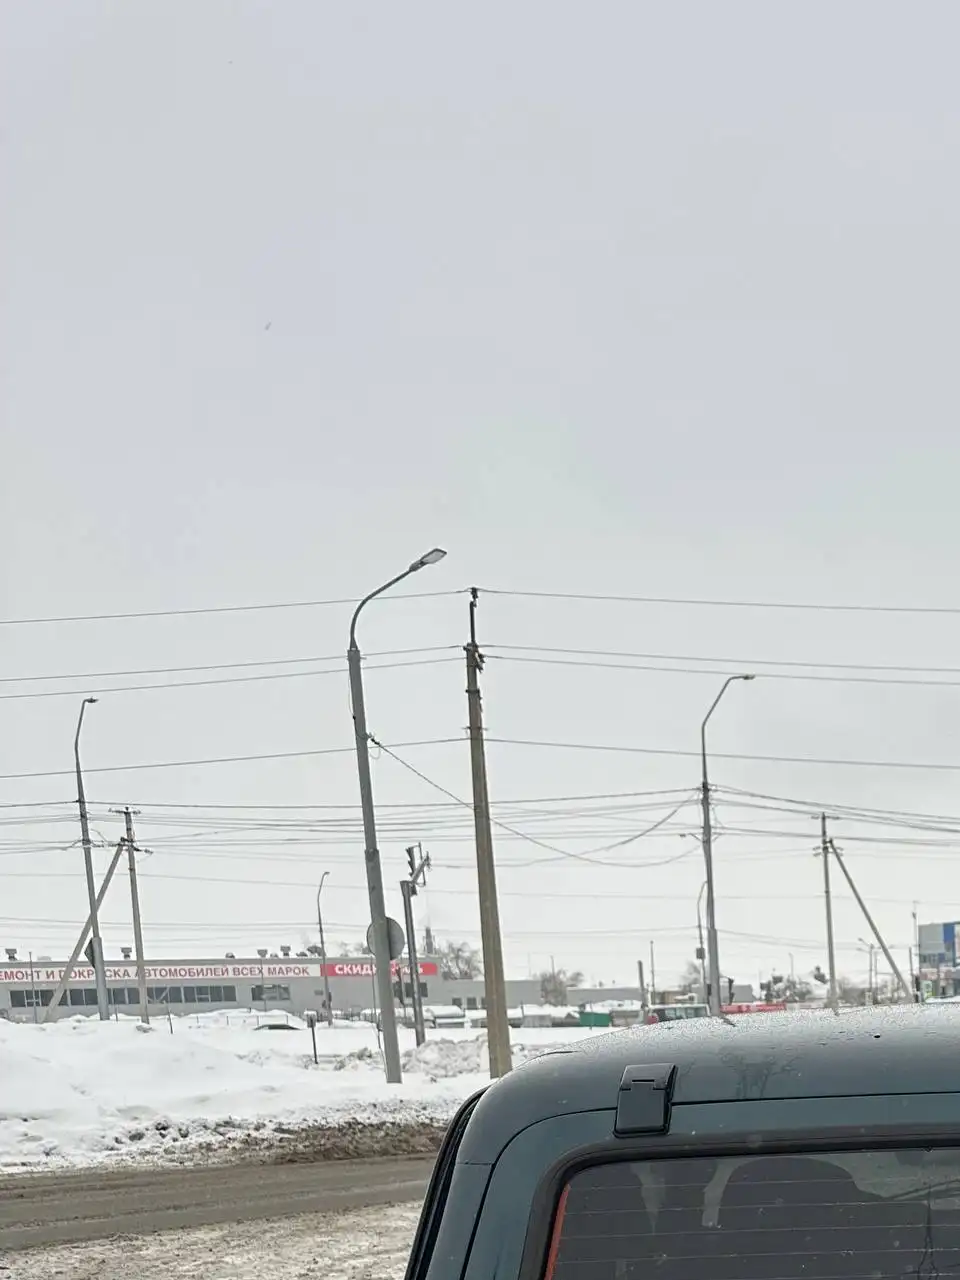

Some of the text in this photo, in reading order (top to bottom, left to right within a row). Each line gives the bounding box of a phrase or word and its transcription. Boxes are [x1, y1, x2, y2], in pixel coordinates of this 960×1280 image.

[46, 970, 55, 980] И
[232, 966, 263, 977] ВСЕХ
[267, 966, 310, 977] МАРОК
